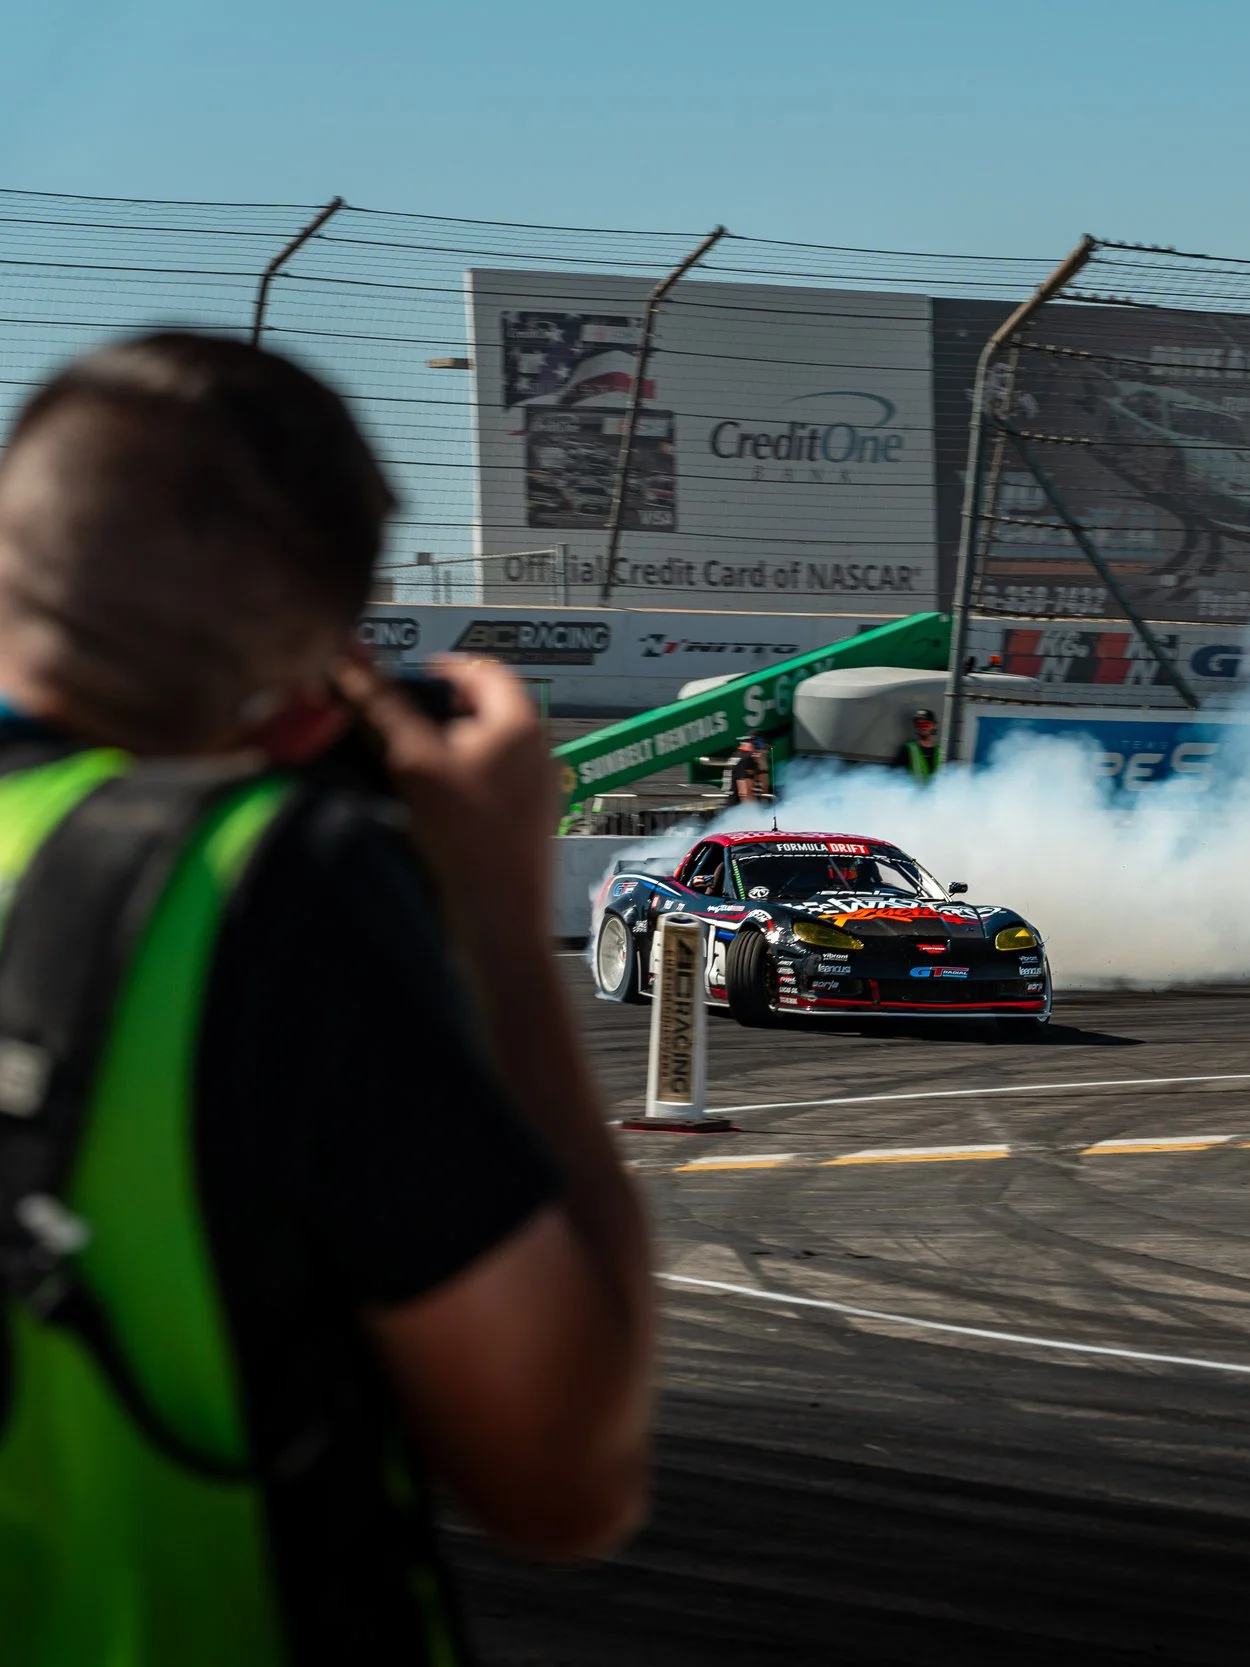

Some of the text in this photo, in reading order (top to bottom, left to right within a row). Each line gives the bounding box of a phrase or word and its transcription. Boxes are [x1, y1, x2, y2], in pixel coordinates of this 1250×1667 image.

[609, 557, 695, 586] Credit
[703, 560, 766, 586] Card
[773, 561, 800, 588] of
[578, 711, 729, 785] SUNBELT RENTALS
[776, 842, 866, 854] FORMULA DRIFT
